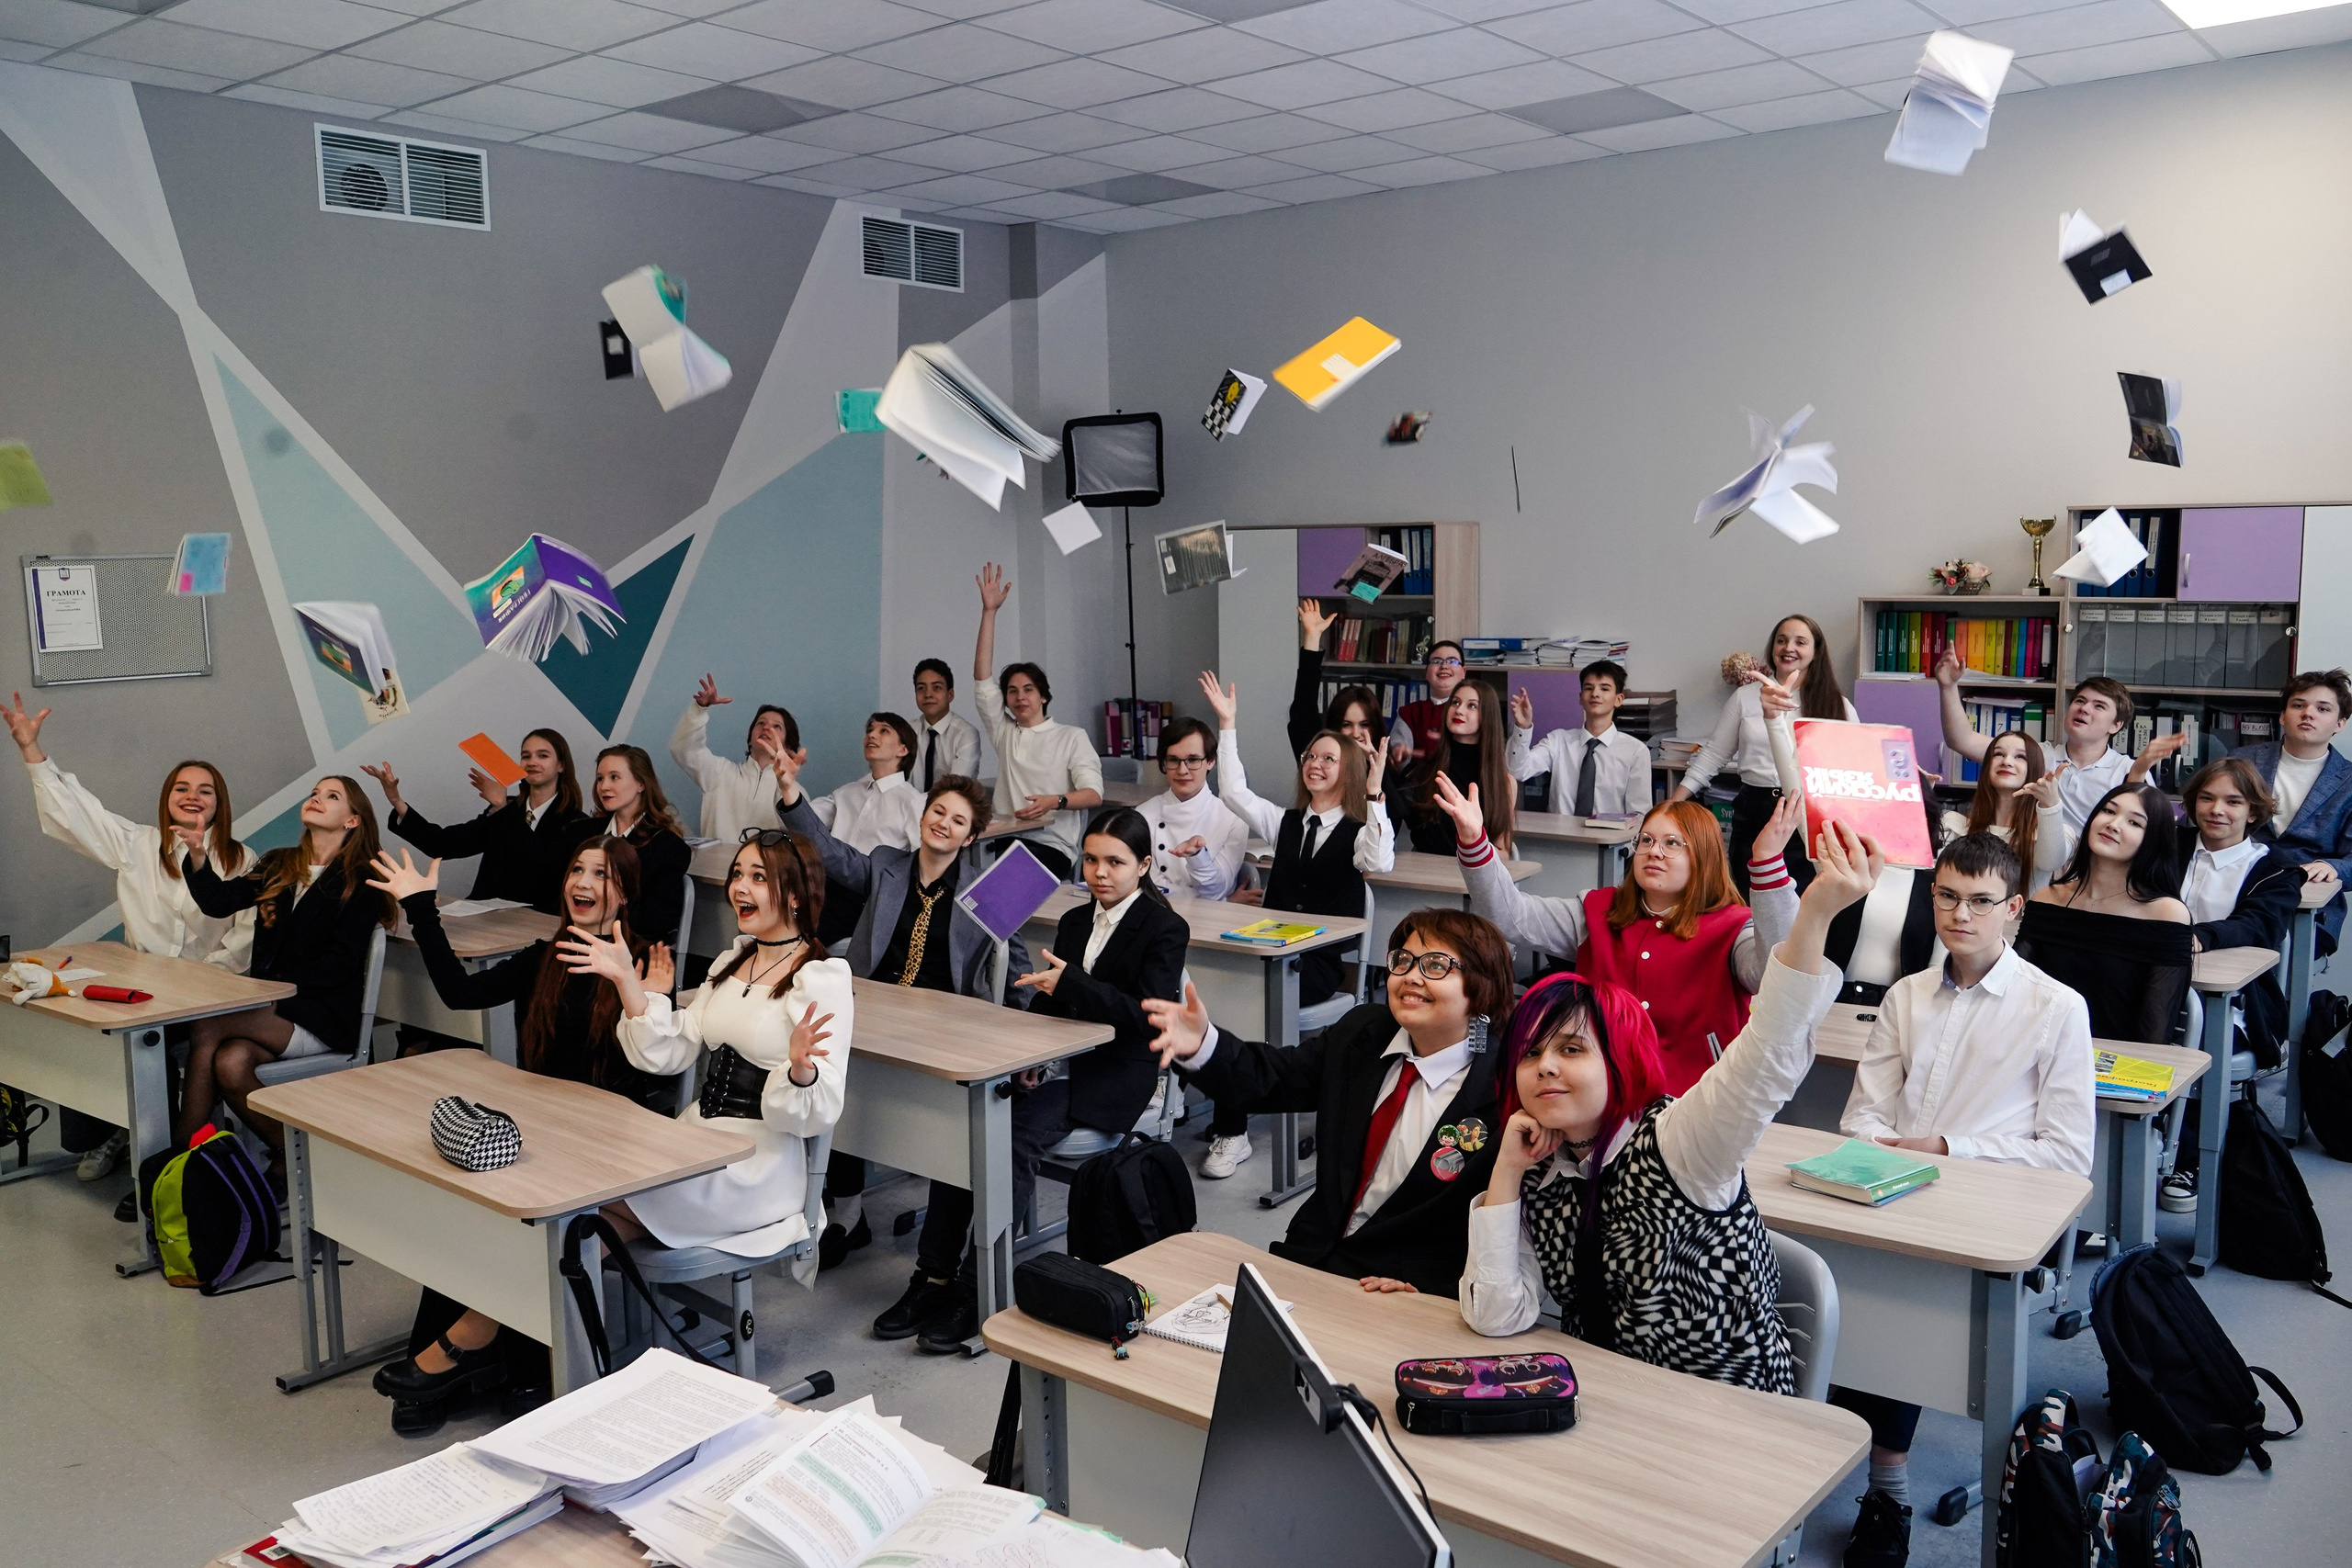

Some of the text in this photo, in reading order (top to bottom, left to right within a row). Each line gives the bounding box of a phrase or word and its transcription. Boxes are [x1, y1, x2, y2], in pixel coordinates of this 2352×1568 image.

[1997, 723, 2003, 732] 7
[1803, 766, 1874, 785] язык
[1805, 779, 1921, 803] русский
